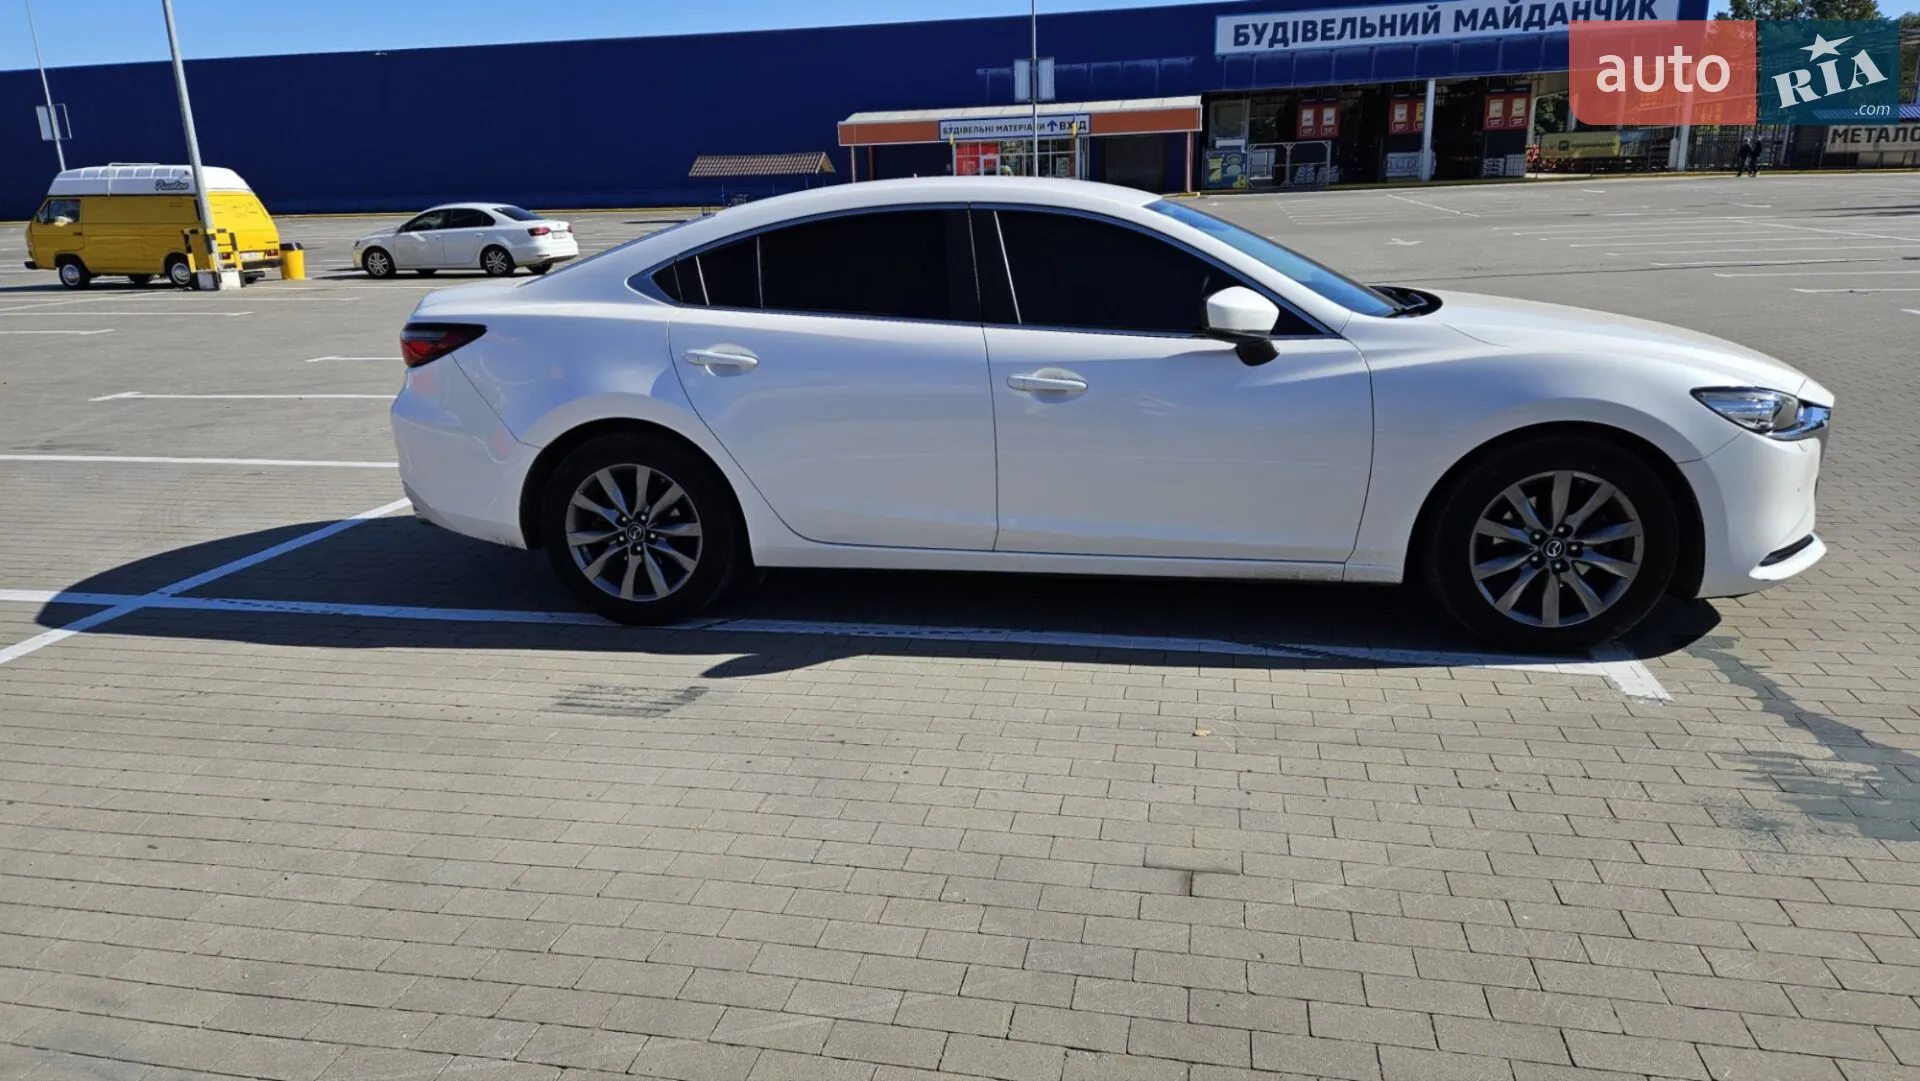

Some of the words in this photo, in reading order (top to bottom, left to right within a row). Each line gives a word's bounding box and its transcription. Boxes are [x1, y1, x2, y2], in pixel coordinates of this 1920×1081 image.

[1233, 5, 1441, 48] БУДІВЕЛЬНИЙ
[1453, 0, 1658, 32] МАЙДАНЧИК
[943, 121, 994, 135] БУДІВЕЛЬНІ
[996, 122, 1045, 132] МАТЕРІАИ
[1059, 119, 1087, 131] ВХД
